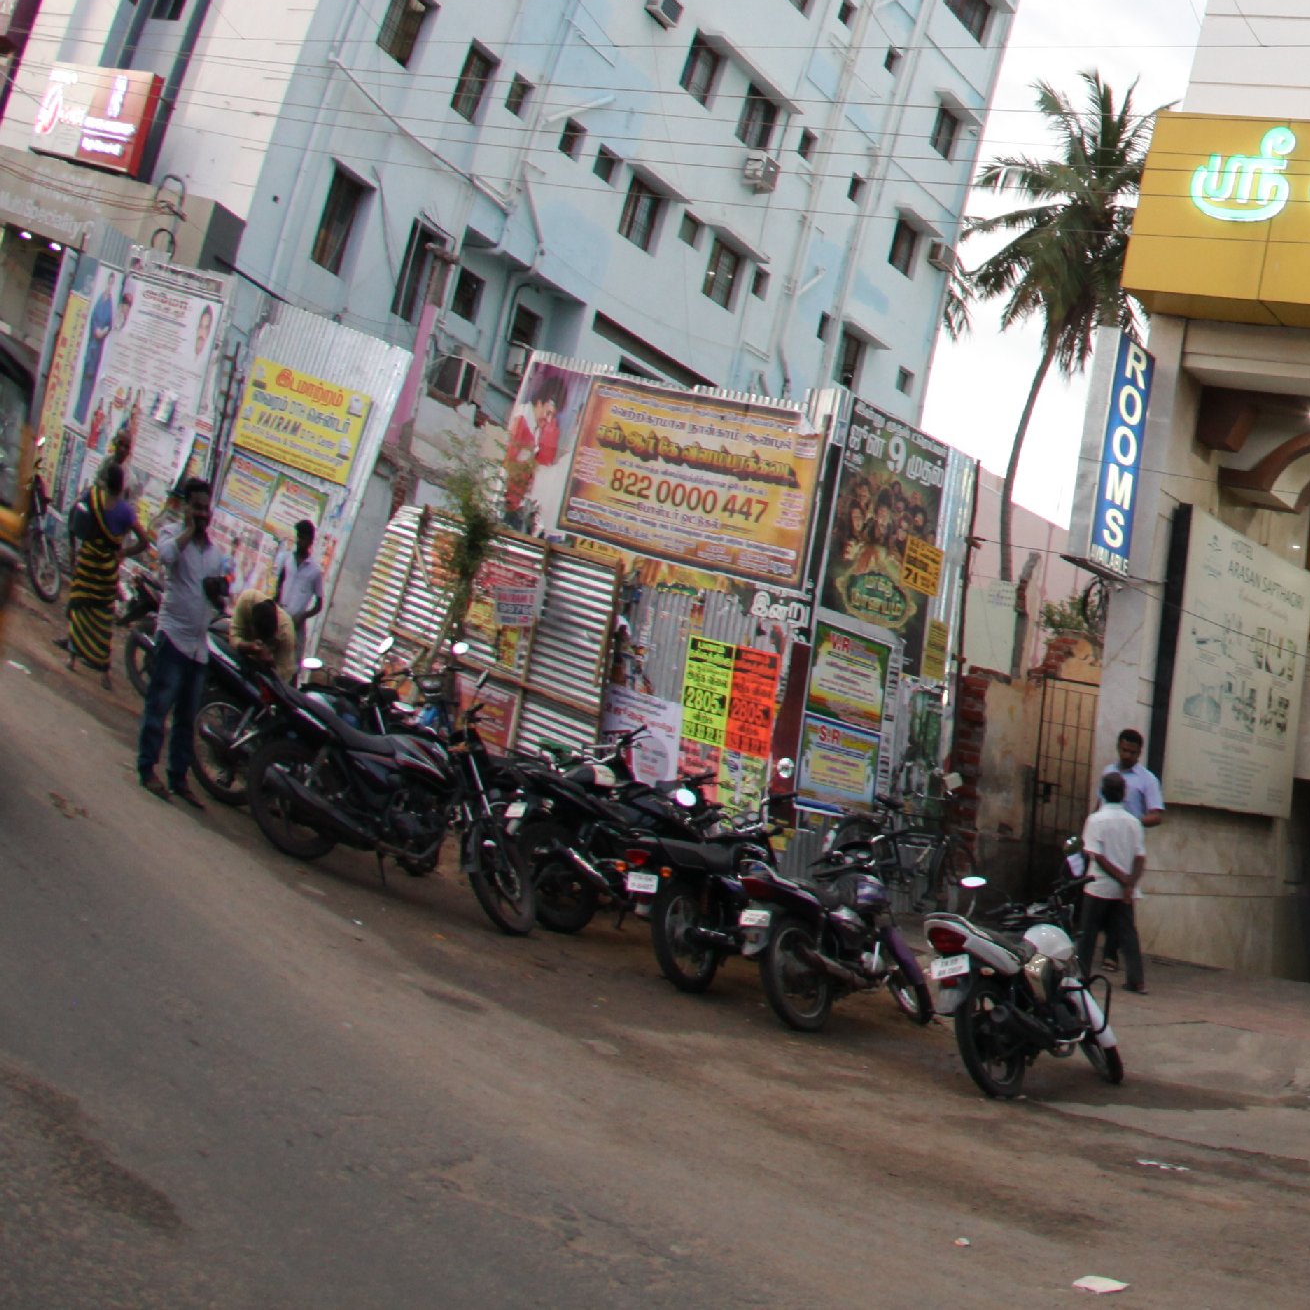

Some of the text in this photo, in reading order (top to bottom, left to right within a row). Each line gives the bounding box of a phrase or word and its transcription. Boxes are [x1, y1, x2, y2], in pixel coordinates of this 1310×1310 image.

[886, 436, 907, 473] 9
[1102, 341, 1147, 549] ROOMS
[610, 467, 652, 500] 822
[655, 479, 719, 515] 0000
[722, 493, 770, 525] 447
[1228, 560, 1260, 588] ARASAN
